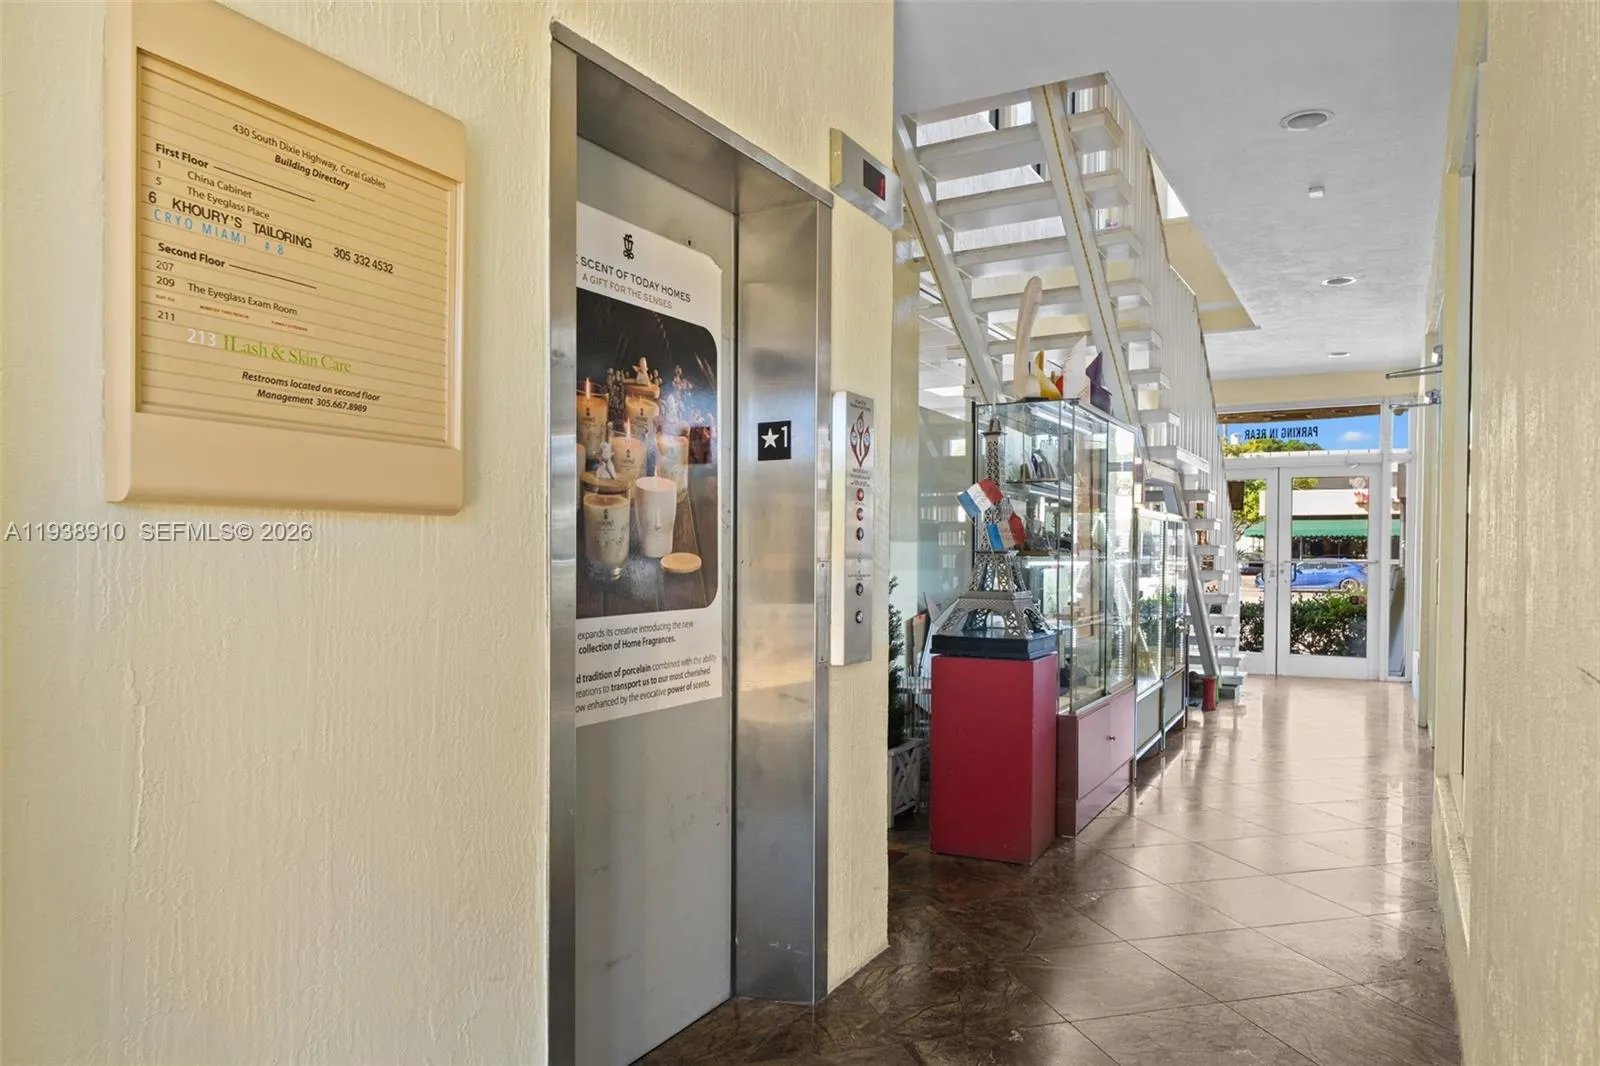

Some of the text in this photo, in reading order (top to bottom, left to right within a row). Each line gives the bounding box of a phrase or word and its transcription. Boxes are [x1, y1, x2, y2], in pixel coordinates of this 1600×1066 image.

[155, 143, 209, 169] First Floor
[232, 123, 386, 190] 430 South Dixie Highway, Coral Gables
[156, 161, 252, 200] 1 China Cabinet
[274, 154, 350, 191] Building Directory
[156, 176, 270, 220] 5 The Eyeglass Place
[148, 192, 394, 274] 6 KHOURY'S TAILORING 305 332 4532
[153, 209, 194, 230] CRYO
[202, 217, 248, 246] MIAMI
[276, 244, 284, 256] 8
[156, 260, 174, 272] 207
[158, 242, 226, 268] Second Floor
[580, 256, 614, 275] SCENT
[616, 269, 629, 280] OF
[630, 273, 660, 292] TODAY
[660, 284, 691, 302] HOMES
[582, 274, 672, 309] A GIFT FOR THE SENSES
[156, 276, 298, 316] 209 The Eyeglass Exam Room
[158, 310, 176, 322] 211
[187, 328, 216, 347] 213
[271, 346, 285, 361] &
[288, 349, 319, 367] Skin
[320, 356, 352, 374] Care
[242, 371, 380, 402] Restrooms located on second floor
[256, 389, 368, 413] Management 305.667.8989
[780, 426, 788, 448] 1
[577, 620, 694, 641] expands its creative introducing the new
[578, 634, 676, 654] collection of Home Fragrances.
[582, 670, 612, 682] tradition
[614, 667, 622, 678] of
[622, 664, 652, 679] porcelain
[652, 660, 680, 672] combined
[680, 658, 692, 666] with
[603, 685, 610, 694] to
[611, 678, 642, 692] transport
[642, 678, 650, 686] us
[650, 676, 658, 685] to
[669, 672, 684, 682] most
[684, 666, 711, 679] cherished
[587, 696, 619, 711] enhanced
[620, 694, 628, 705] by
[629, 692, 639, 702] the
[640, 688, 666, 700] evocative
[667, 684, 686, 696] power
[686, 680, 692, 690] of
[692, 680, 711, 690] scents.
